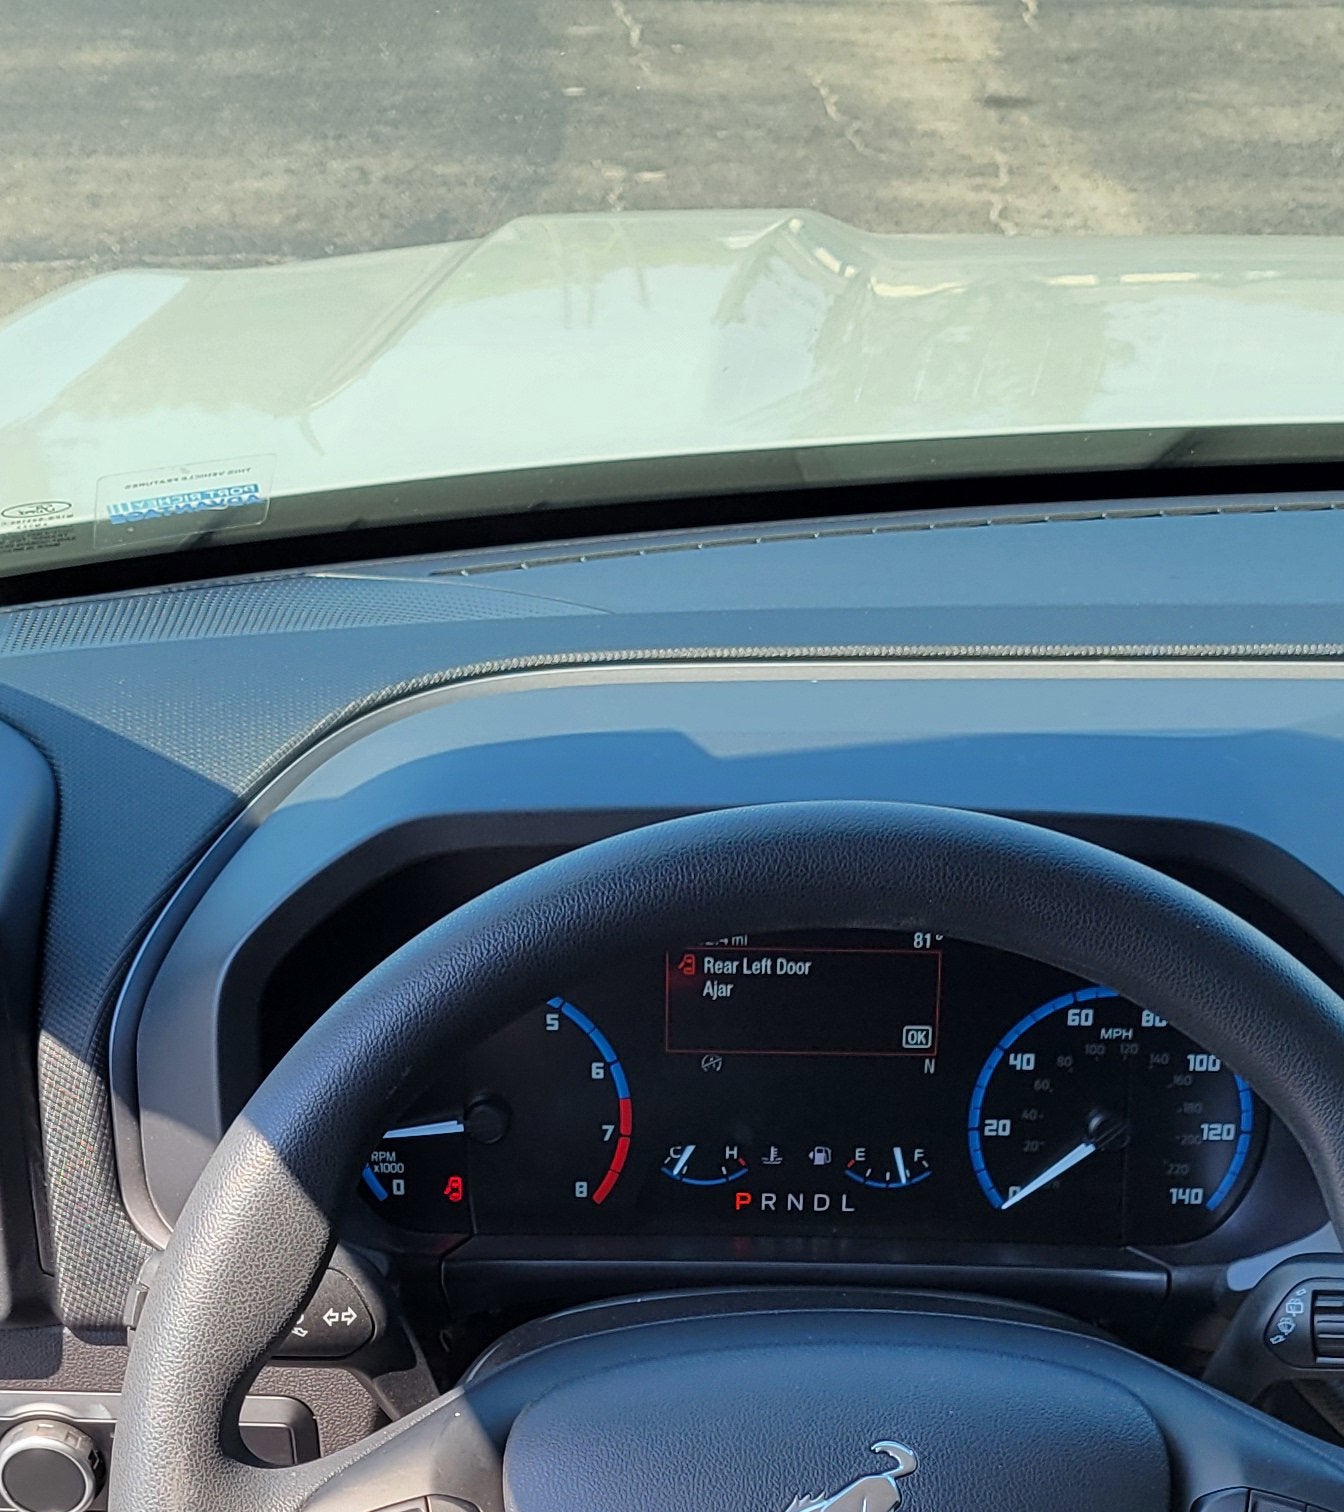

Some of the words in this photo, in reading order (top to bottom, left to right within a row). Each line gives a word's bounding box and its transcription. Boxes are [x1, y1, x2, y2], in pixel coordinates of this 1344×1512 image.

[703, 956, 740, 975] Rear
[742, 957, 772, 975] Left
[775, 957, 812, 975] Door
[702, 980, 734, 1000] Ajar
[545, 1013, 560, 1031] 5
[1067, 1008, 1094, 1026] 60
[907, 1030, 927, 1045] OK
[1100, 1028, 1133, 1040] MPH
[923, 1057, 936, 1074] N
[1009, 1053, 1035, 1070] 40
[1186, 1054, 1221, 1072] 100
[591, 1061, 605, 1080] 6
[601, 1125, 615, 1142] 7
[984, 1119, 1011, 1136] 20
[1200, 1123, 1235, 1140] 120
[371, 1151, 396, 1162] RPM
[725, 1146, 738, 1159] H
[855, 1148, 866, 1161] E
[913, 1149, 925, 1162] F
[373, 1162, 405, 1174] x1000
[392, 1179, 405, 1196] 0
[575, 1181, 588, 1198] 8
[735, 1192, 752, 1210] P
[761, 1192, 776, 1211] R
[787, 1192, 804, 1211] N
[813, 1193, 831, 1211] D
[841, 1194, 855, 1212] L
[1169, 1188, 1204, 1205] 140
